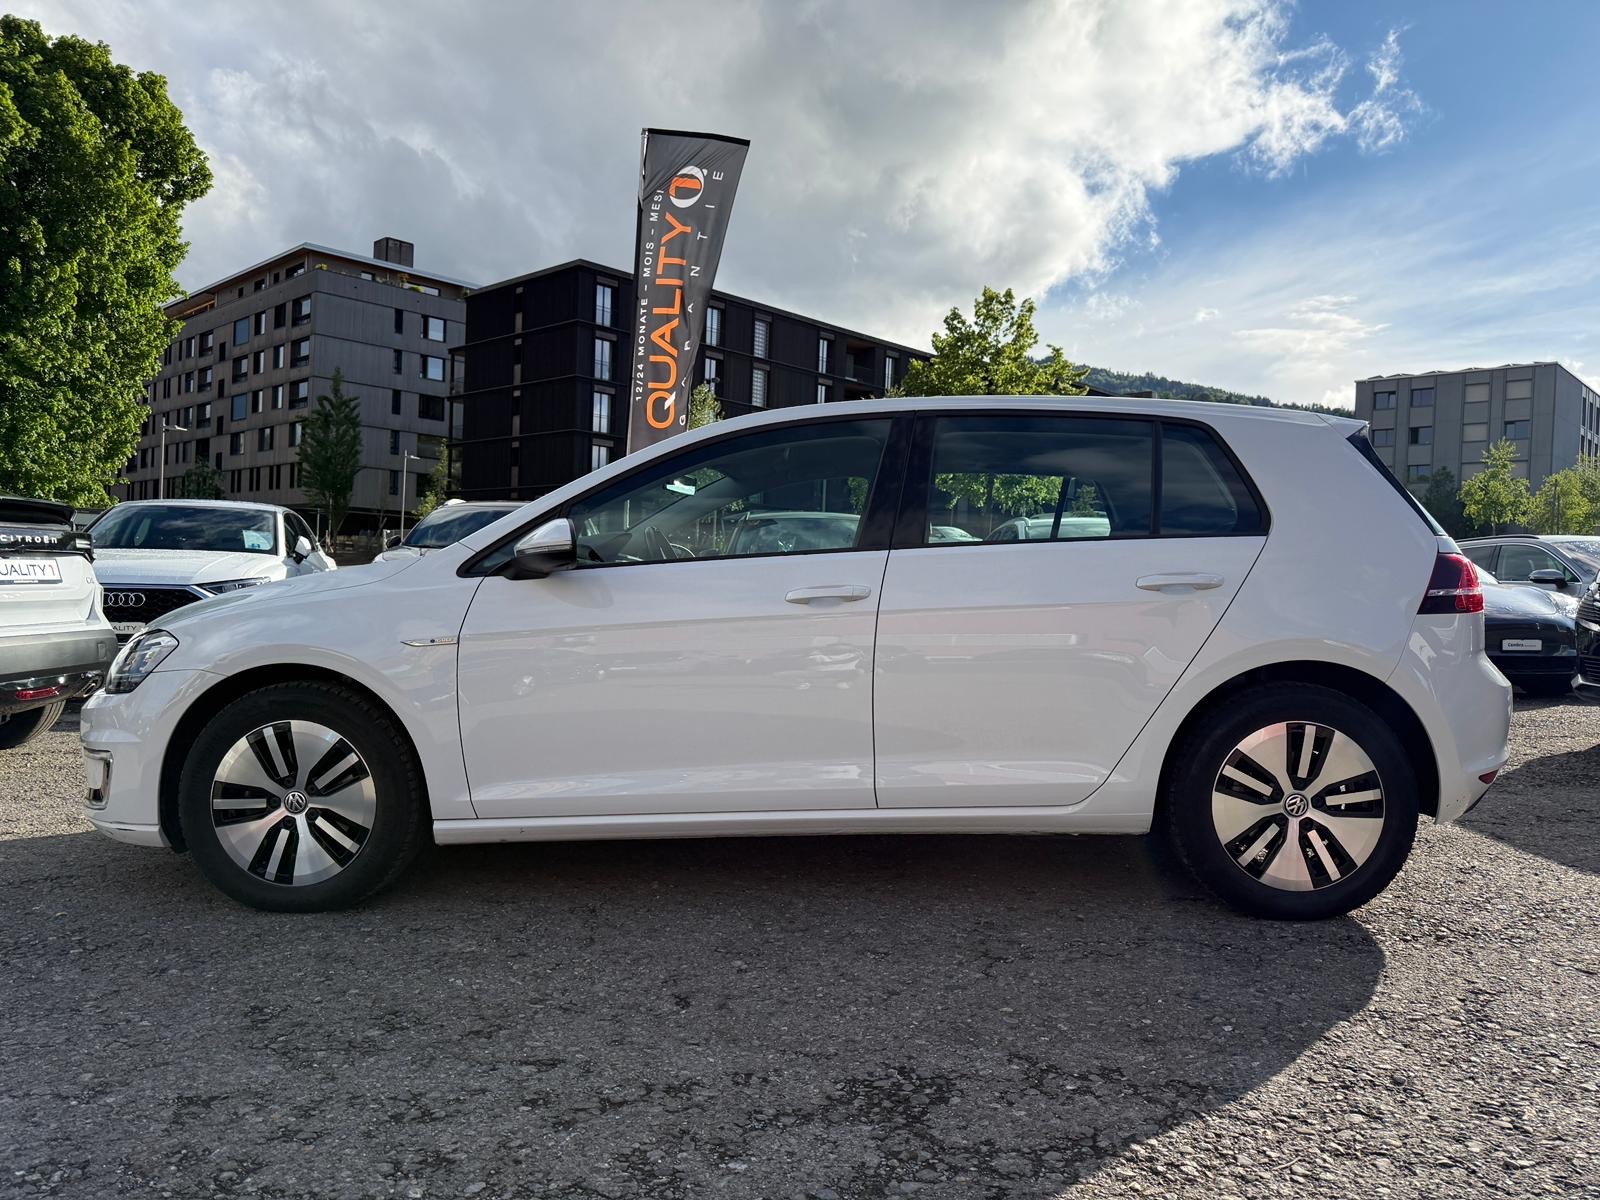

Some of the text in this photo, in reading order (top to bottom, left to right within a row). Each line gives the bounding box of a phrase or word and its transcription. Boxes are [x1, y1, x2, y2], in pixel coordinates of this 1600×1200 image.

[649, 189, 665, 222] MESI
[643, 242, 655, 277] MOIS
[638, 298, 648, 356] MONATE
[646, 211, 692, 429] QUALITY
[635, 364, 644, 401] 12/24
[0, 564, 55, 576] UALITY 1
